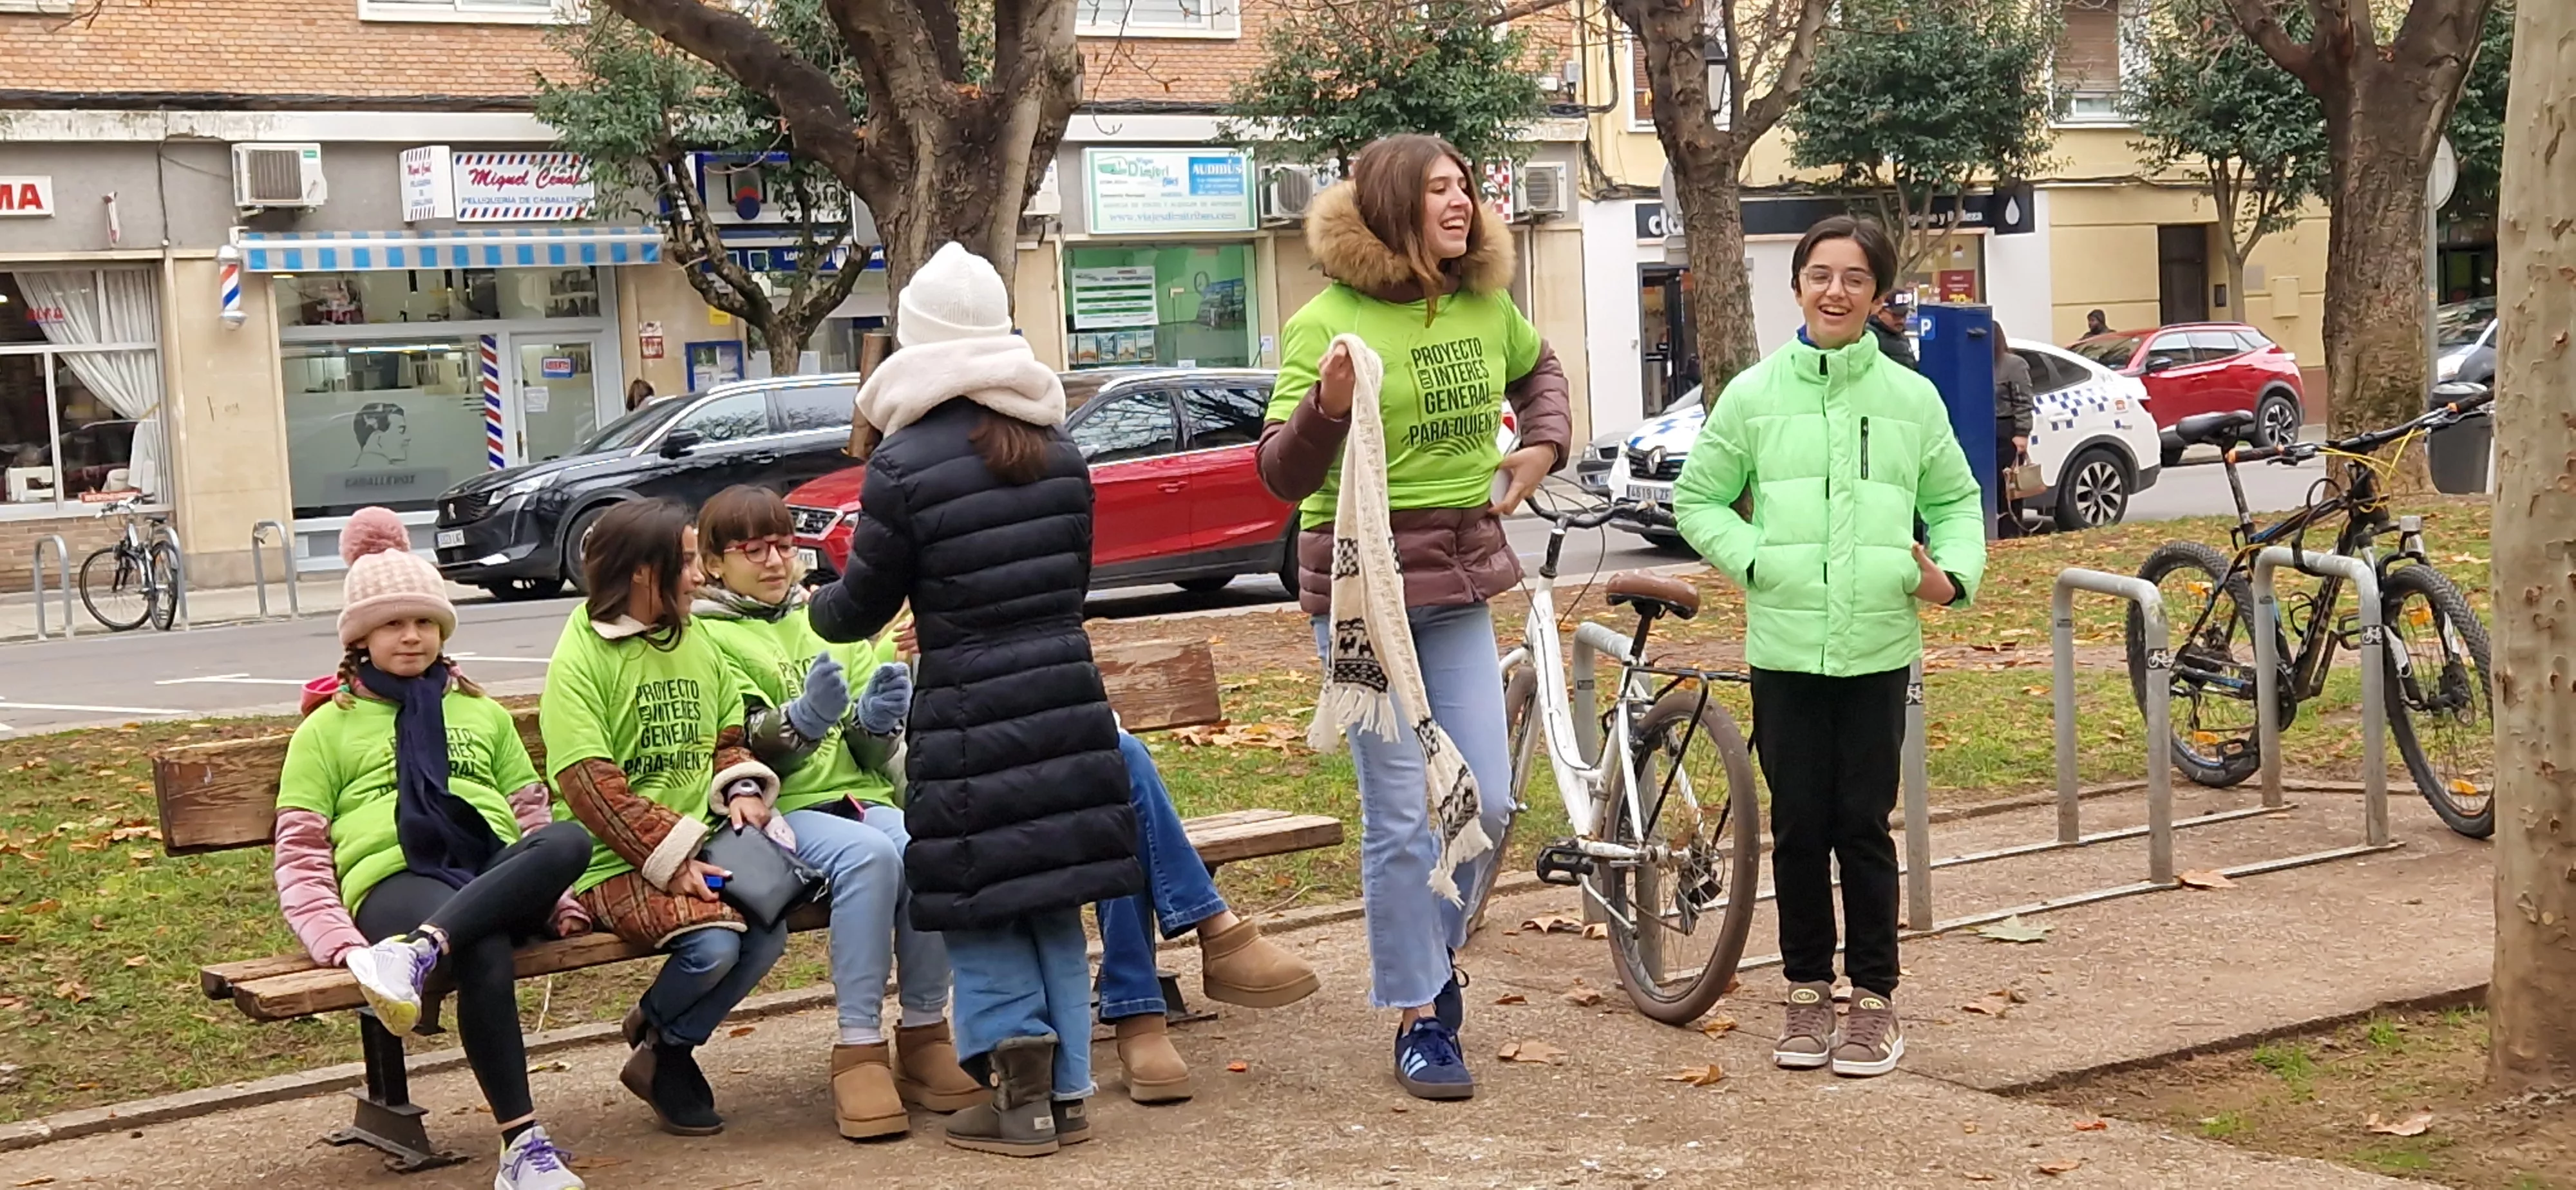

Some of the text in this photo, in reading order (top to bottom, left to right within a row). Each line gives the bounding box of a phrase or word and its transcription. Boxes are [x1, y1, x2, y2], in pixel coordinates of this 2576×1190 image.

[468, 168, 529, 191] Miguel
[1921, 319, 1932, 336] P
[1410, 337, 1483, 369] PROYECTO
[1432, 359, 1490, 388] INTERES
[1425, 381, 1492, 415] GENERAL
[1409, 419, 1449, 446] PARA
[636, 679, 699, 706] PROYECTO
[653, 701, 701, 722] INTERES
[641, 722, 701, 748] GENERAL
[624, 754, 664, 776] PARA
